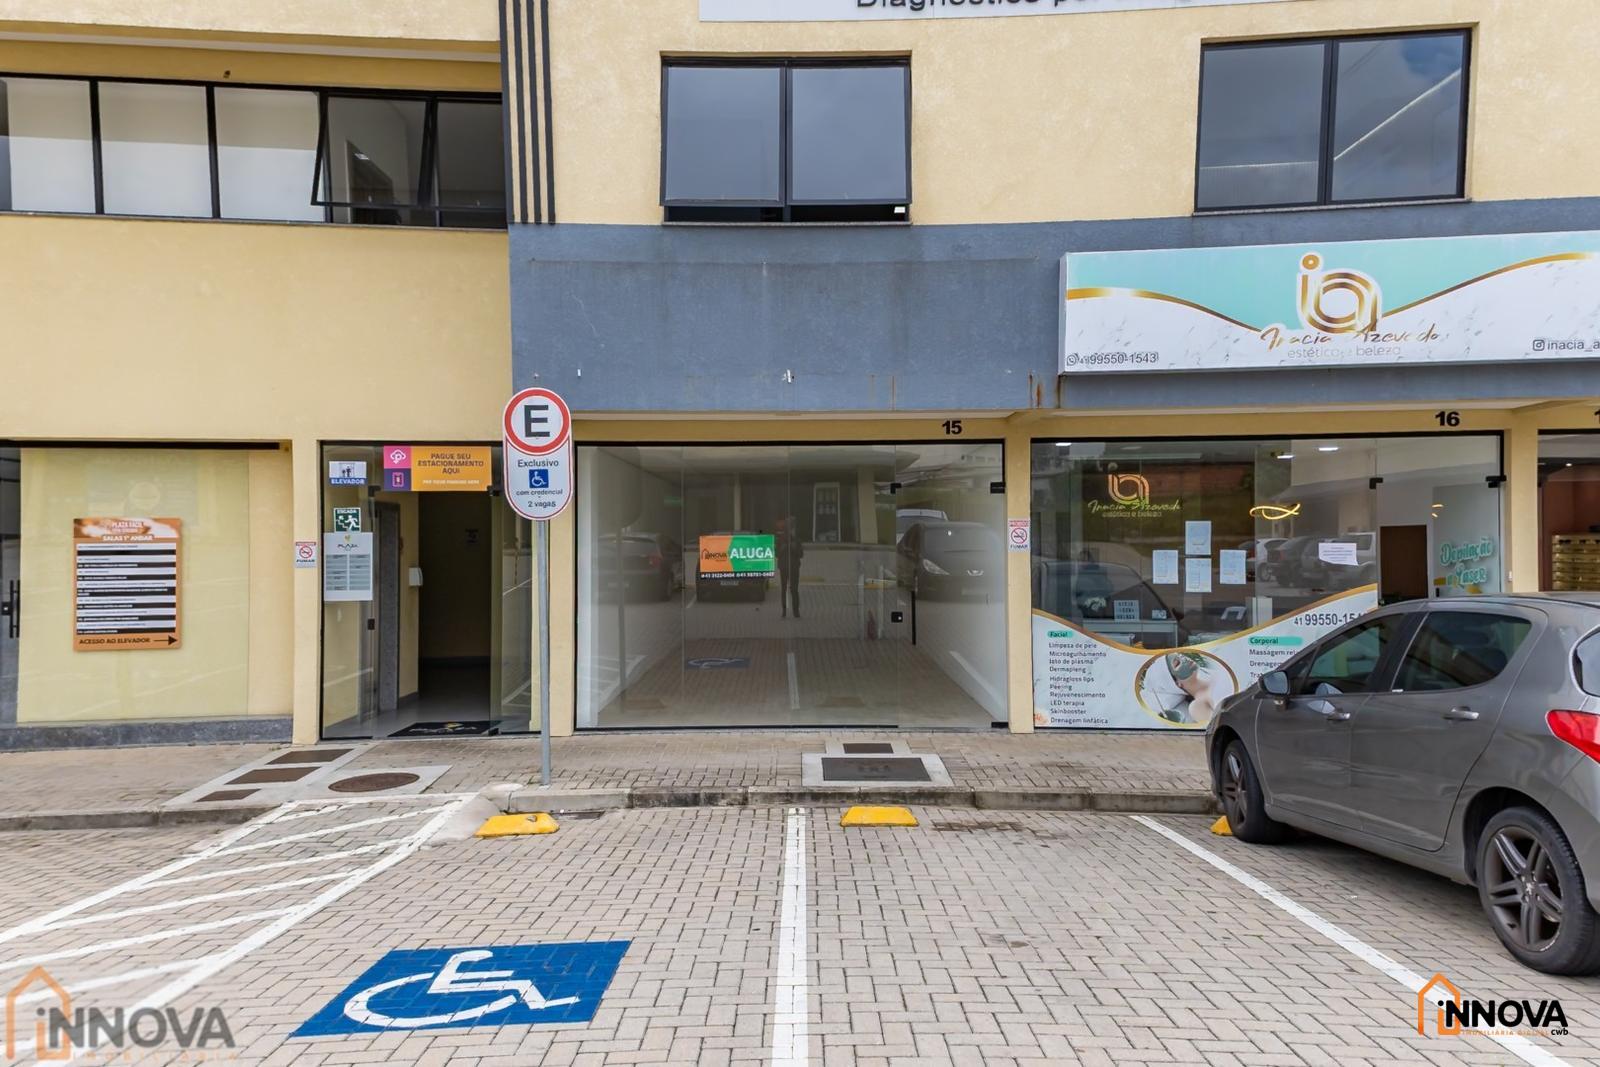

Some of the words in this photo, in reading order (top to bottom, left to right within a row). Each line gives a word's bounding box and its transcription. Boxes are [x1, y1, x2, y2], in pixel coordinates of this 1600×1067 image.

[524, 404, 550, 437] E
[1435, 411, 1460, 427] 16
[942, 420, 962, 435] 15
[518, 459, 559, 468] Exclusivo
[535, 501, 556, 509] vagas
[730, 547, 773, 559] ALUGA
[1294, 617, 1303, 625] 41
[1250, 636, 1279, 645] Corporal
[1249, 649, 1286, 657] Massagem
[1050, 717, 1082, 725] Drenagem
